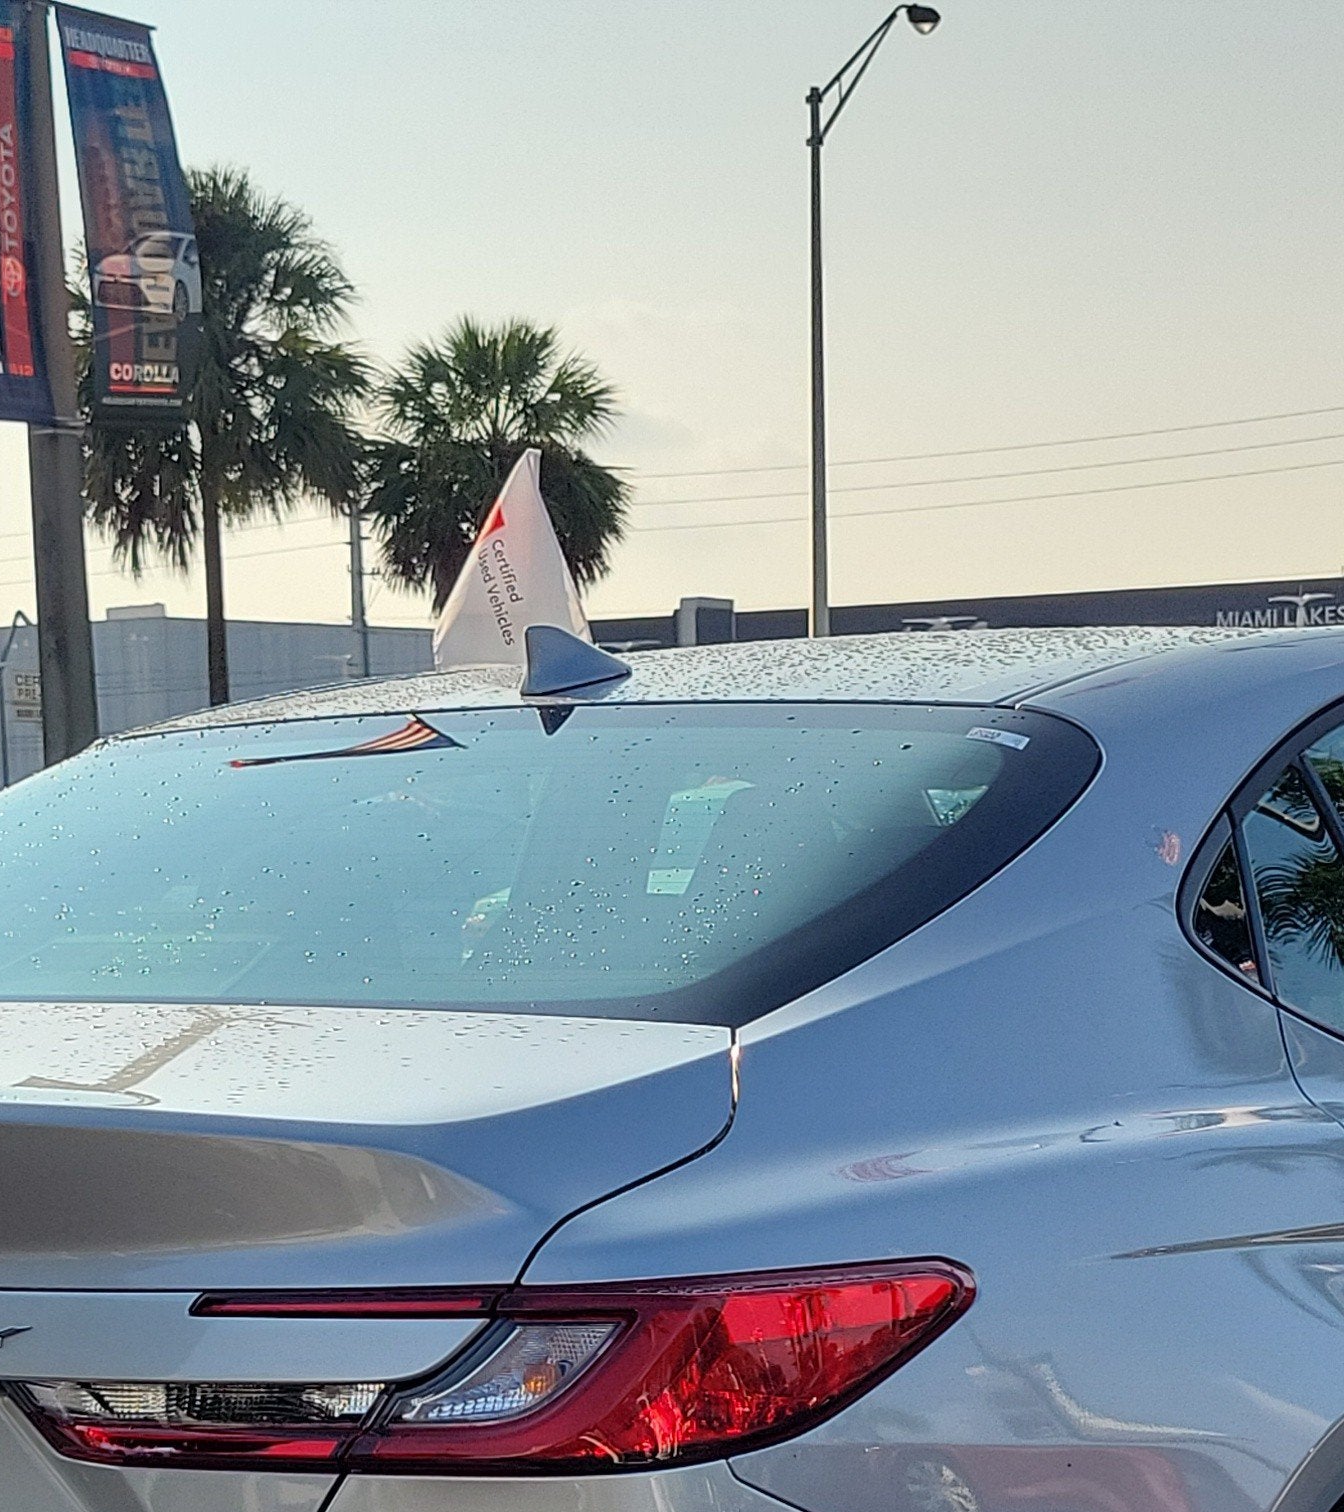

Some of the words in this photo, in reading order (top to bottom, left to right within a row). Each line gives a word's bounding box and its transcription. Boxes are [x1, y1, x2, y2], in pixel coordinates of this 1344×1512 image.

[110, 362, 180, 384] COROLLA
[492, 539, 524, 603] Certified
[478, 547, 495, 584] Used
[487, 583, 515, 646] Vehicles
[1216, 607, 1278, 628] MIAMI
